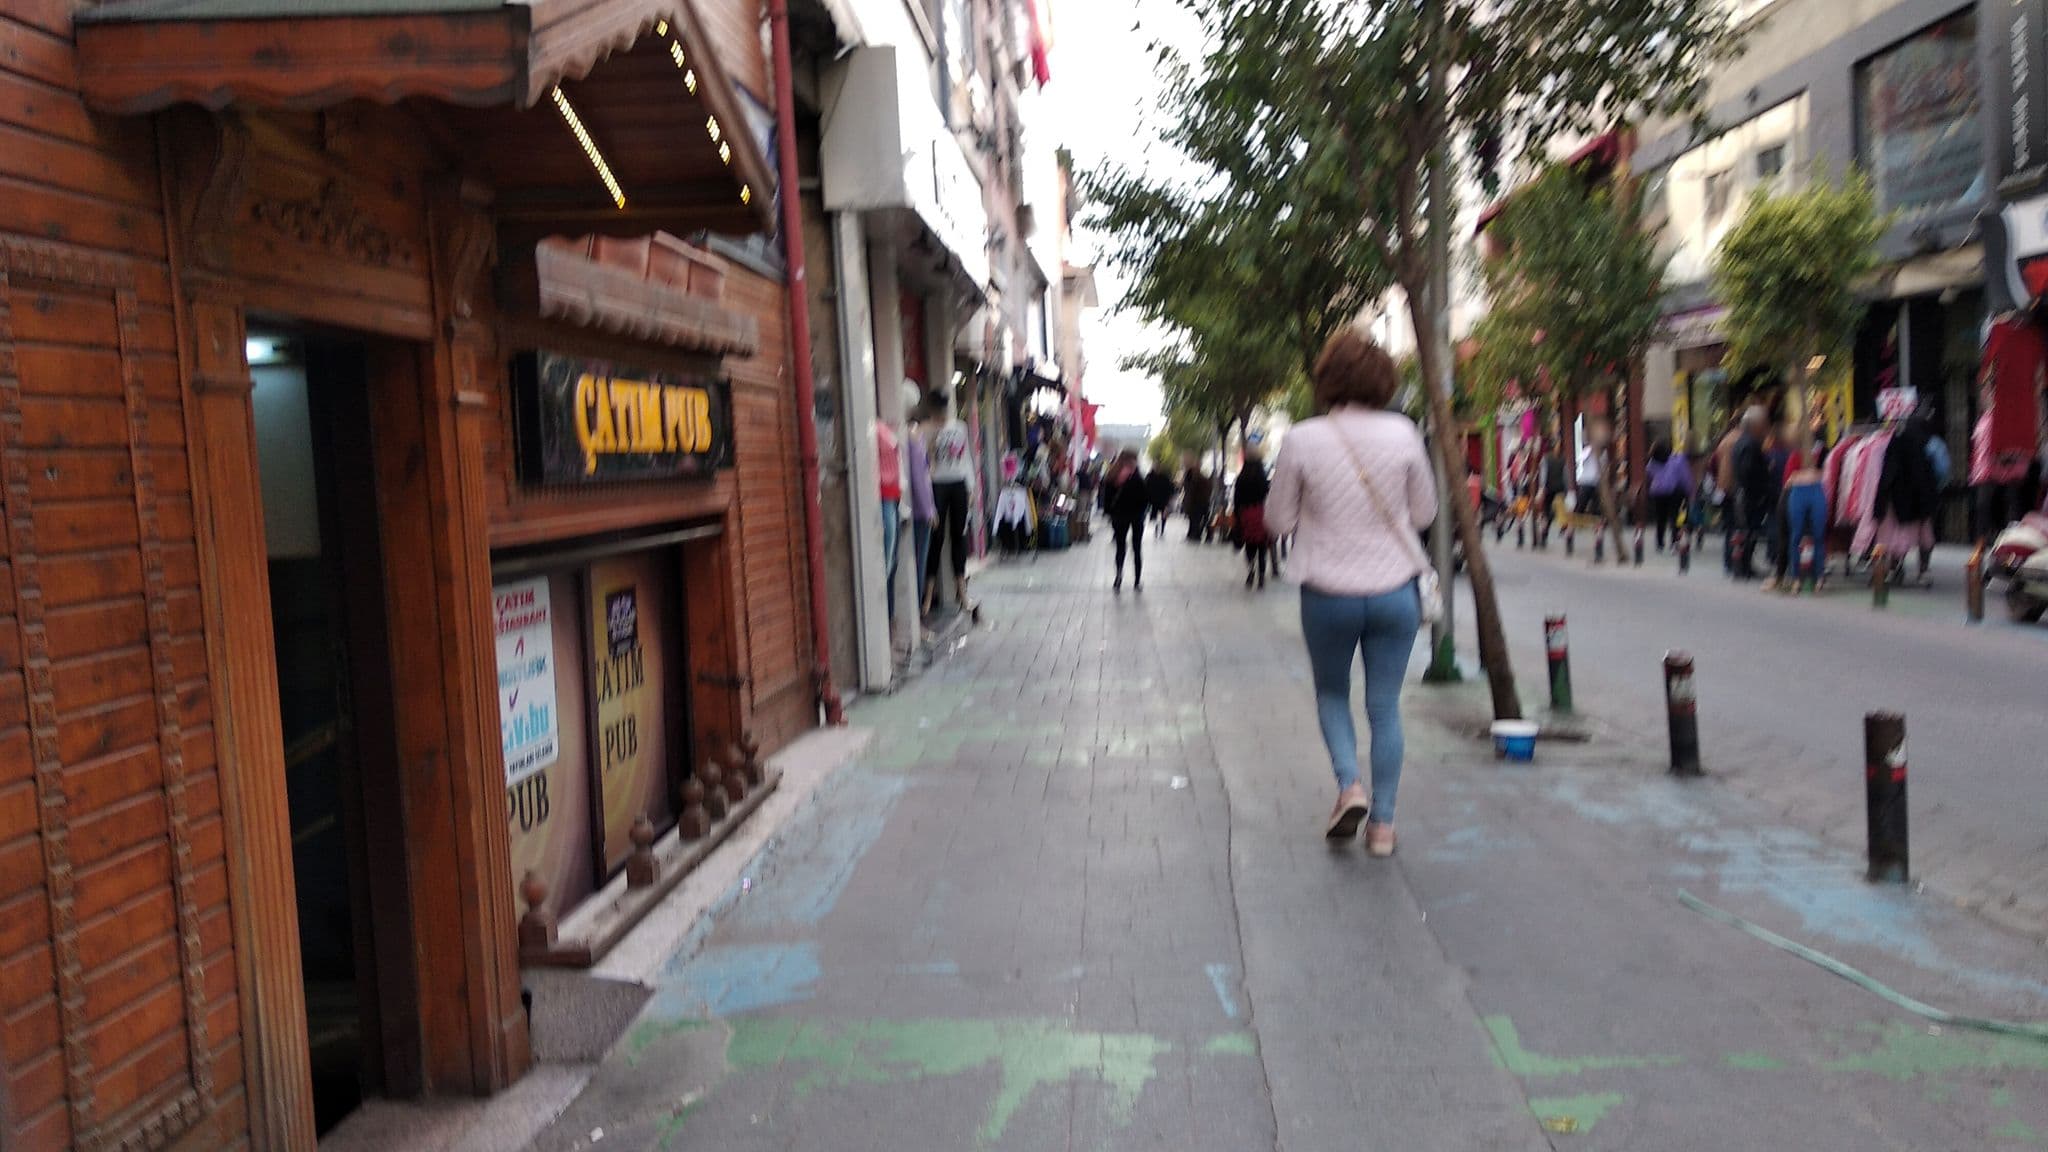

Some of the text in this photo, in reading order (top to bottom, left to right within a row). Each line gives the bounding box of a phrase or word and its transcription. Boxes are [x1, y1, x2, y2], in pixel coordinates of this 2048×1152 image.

[664, 384, 712, 454] PUB
[597, 643, 645, 704] ATIM
[605, 715, 637, 769] PUB
